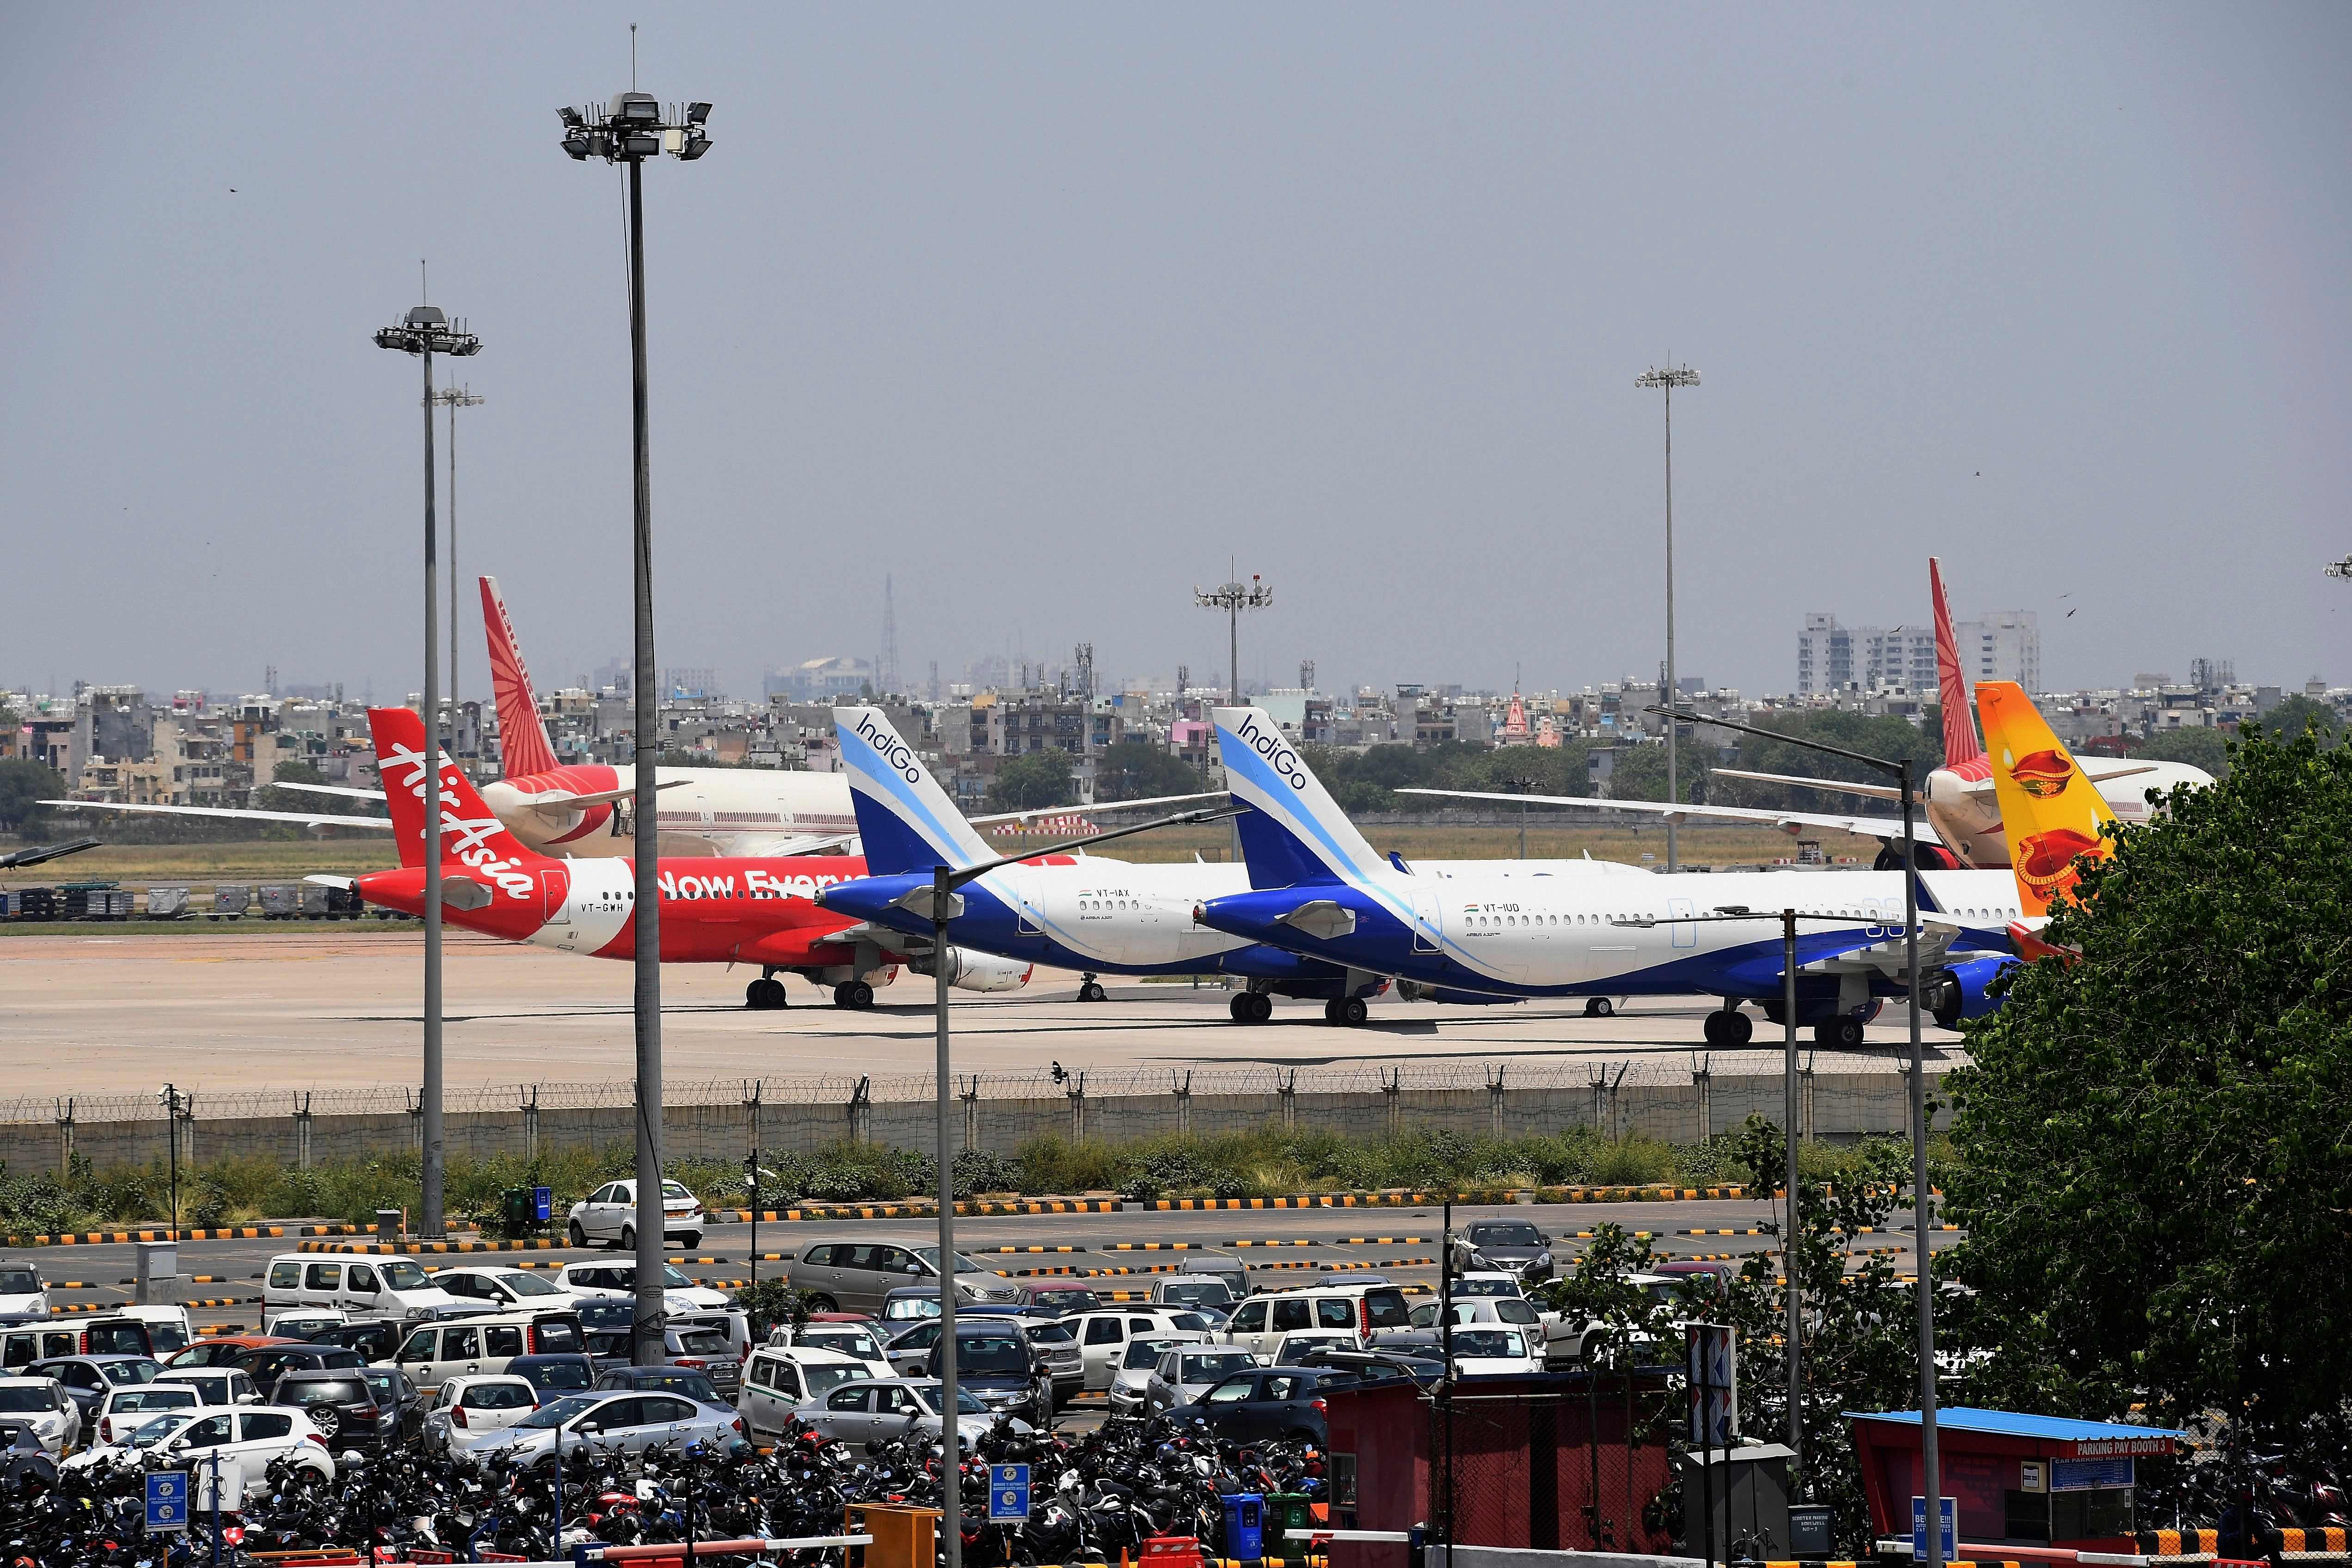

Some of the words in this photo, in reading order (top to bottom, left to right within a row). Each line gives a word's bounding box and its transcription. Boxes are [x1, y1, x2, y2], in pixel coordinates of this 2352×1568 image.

[856, 712, 919, 783] IndiGo
[1237, 713, 1306, 790] IndiGo
[581, 903, 623, 912] VT-GWH
[1483, 904, 1519, 912] VT-IUD
[2078, 1442, 2113, 1455] PARKING
[2114, 1441, 2129, 1454] PAY
[2131, 1440, 2158, 1453] BOOTH
[2161, 1440, 2165, 1452] 3
